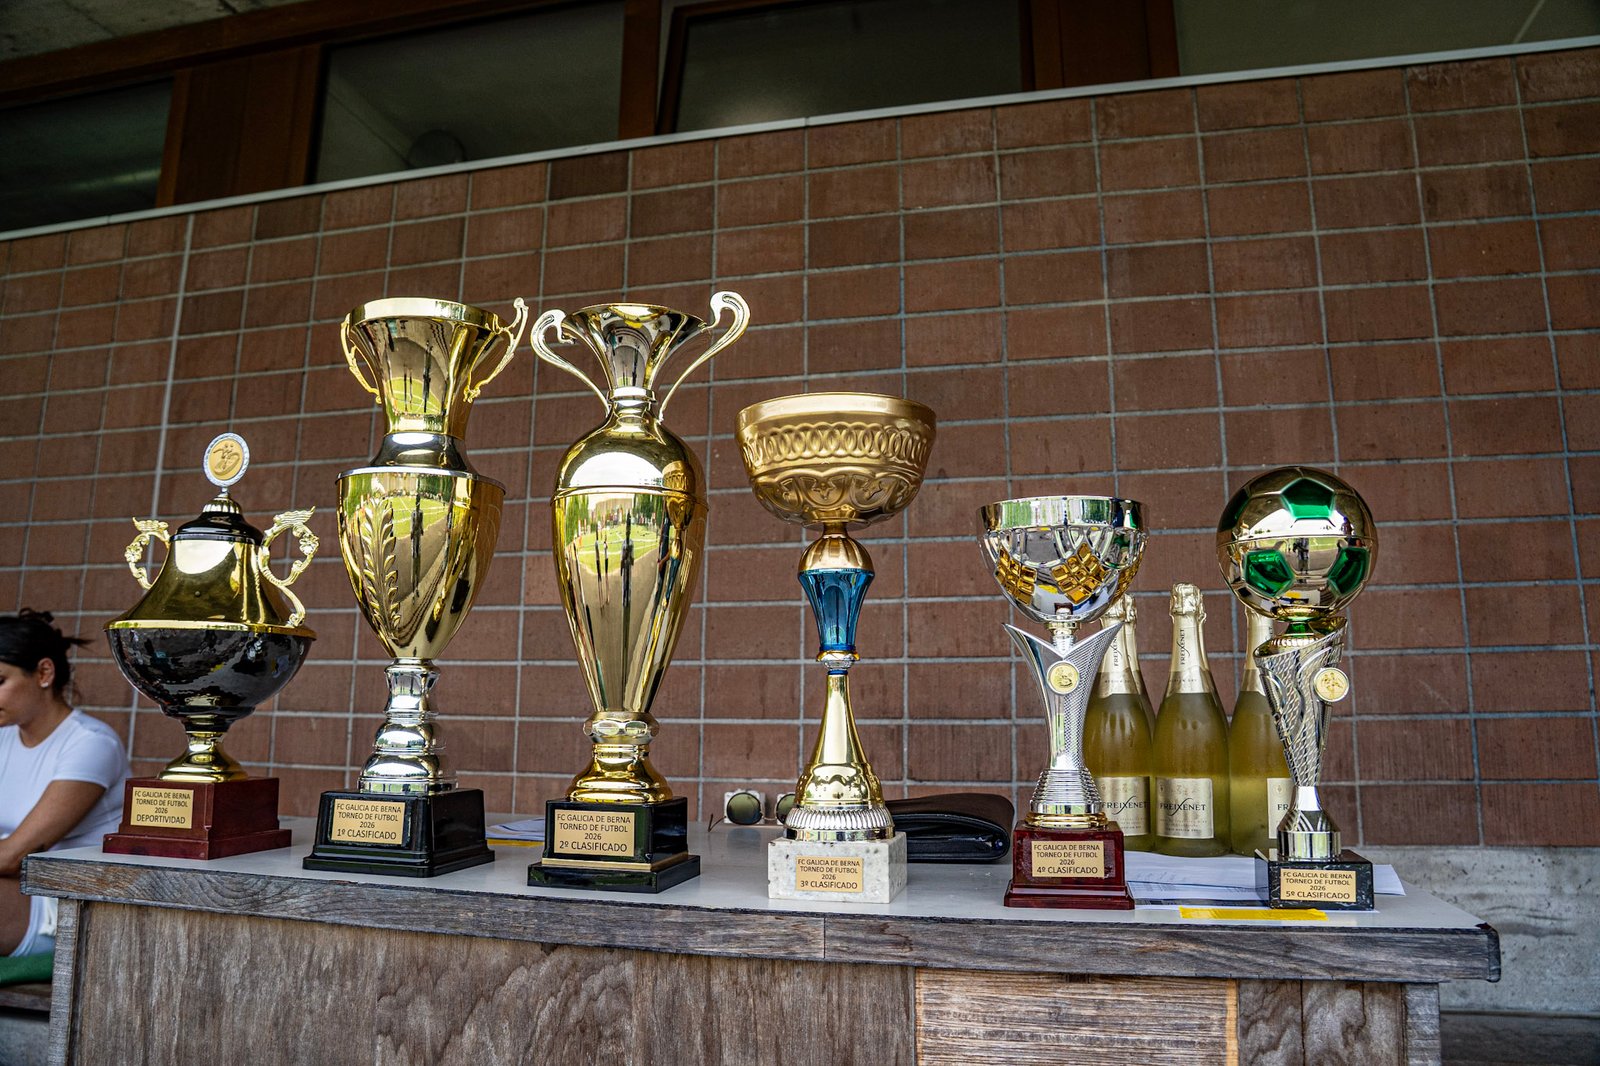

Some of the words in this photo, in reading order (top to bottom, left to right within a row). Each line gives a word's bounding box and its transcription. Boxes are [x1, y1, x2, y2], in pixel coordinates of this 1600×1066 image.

[1160, 798, 1206, 816] FREIXENET
[136, 814, 186, 824] DEPORTIVIDAD
[567, 814, 594, 822] GALICIA
[559, 823, 588, 831] TORNEO
[347, 829, 397, 840] CLASIFICADO
[571, 841, 627, 852] CLASIFICADO
[810, 881, 858, 889] CLASIFICADO
[1297, 891, 1350, 899] CLASIFICADO
